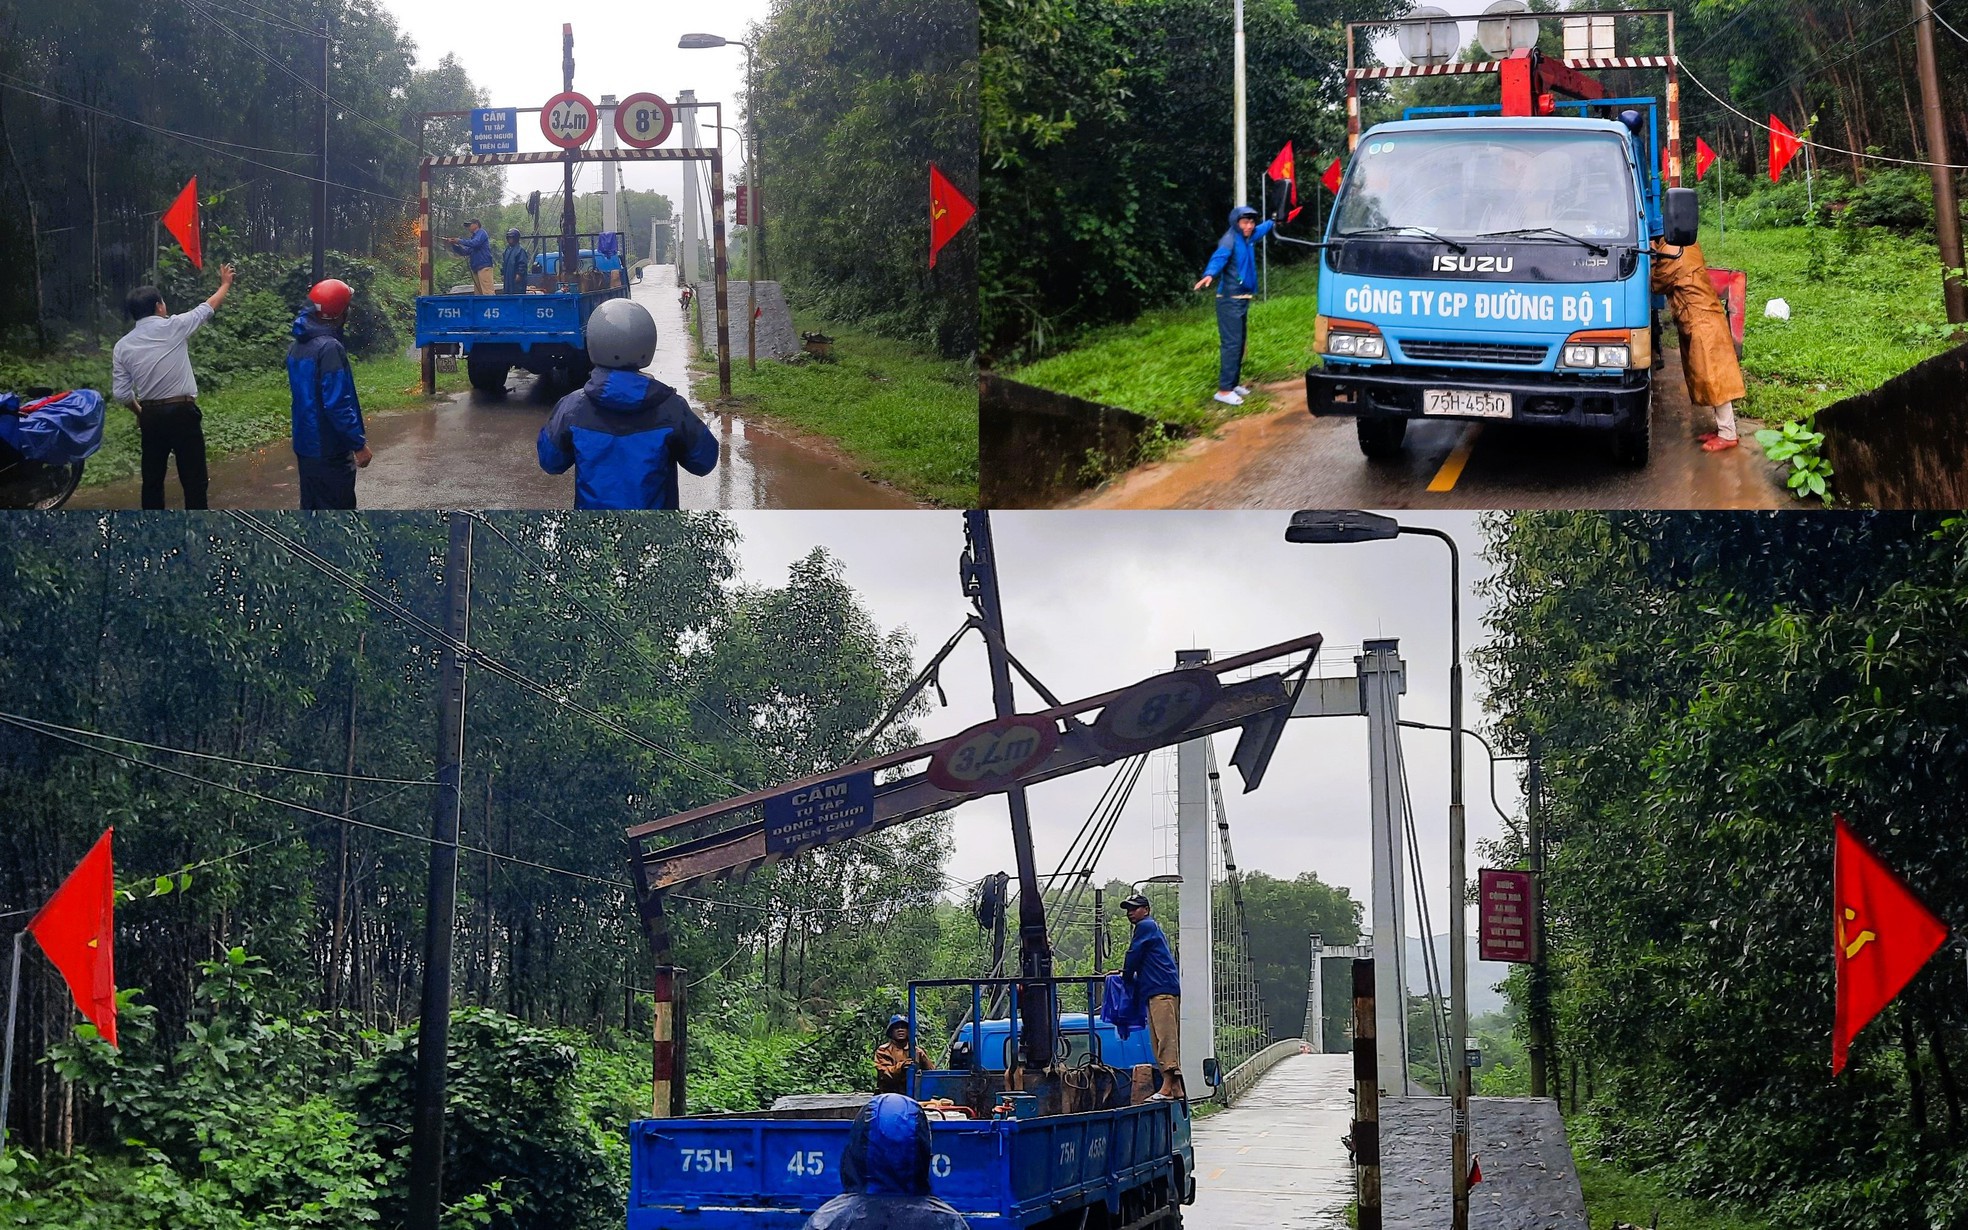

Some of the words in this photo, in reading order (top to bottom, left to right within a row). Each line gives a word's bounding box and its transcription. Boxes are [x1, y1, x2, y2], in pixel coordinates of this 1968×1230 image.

[1432, 255, 1514, 273] ISUZU
[437, 308, 461, 319] 75H
[483, 308, 500, 319] 45
[1345, 284, 1402, 315] CÔNG
[1409, 291, 1435, 316] TY
[1438, 291, 1468, 317] CP
[1474, 288, 1554, 321] ĐƯỜNG
[1562, 291, 1594, 326] BỘ
[1602, 297, 1612, 323] 1
[1430, 395, 1505, 413] 75H-4550
[680, 1148, 733, 1172] 75H
[787, 1150, 824, 1176] 45
[1060, 1141, 1075, 1166] 75H
